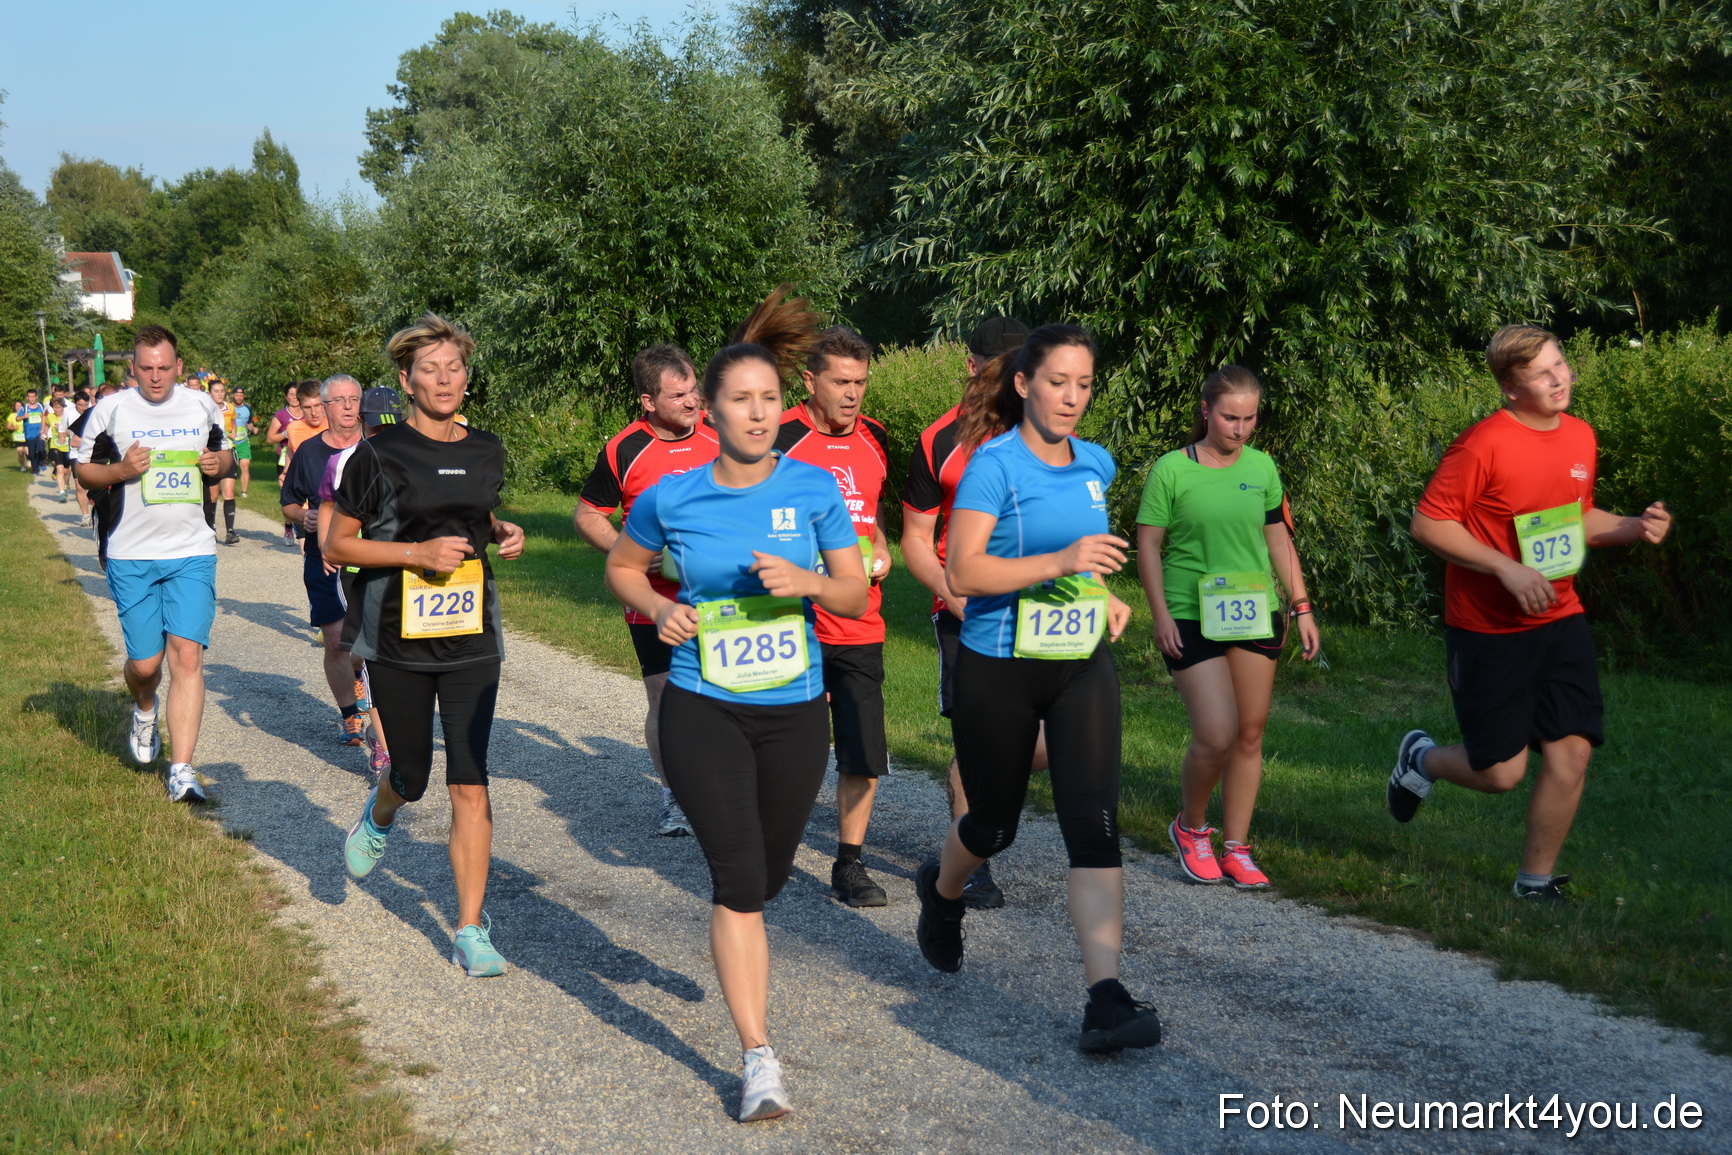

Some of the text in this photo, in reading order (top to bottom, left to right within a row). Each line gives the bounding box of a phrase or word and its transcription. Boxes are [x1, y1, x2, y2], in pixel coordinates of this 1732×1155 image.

[131, 428, 200, 439] DELPHI
[155, 471, 192, 489] 264
[1532, 534, 1572, 563] 973
[413, 590, 475, 617] 1228
[1215, 599, 1257, 622] 133
[422, 620, 445, 628] Christine
[1028, 607, 1096, 636] 1281
[712, 629, 797, 668] 1285
[736, 668, 778, 679] Julia Mederer
